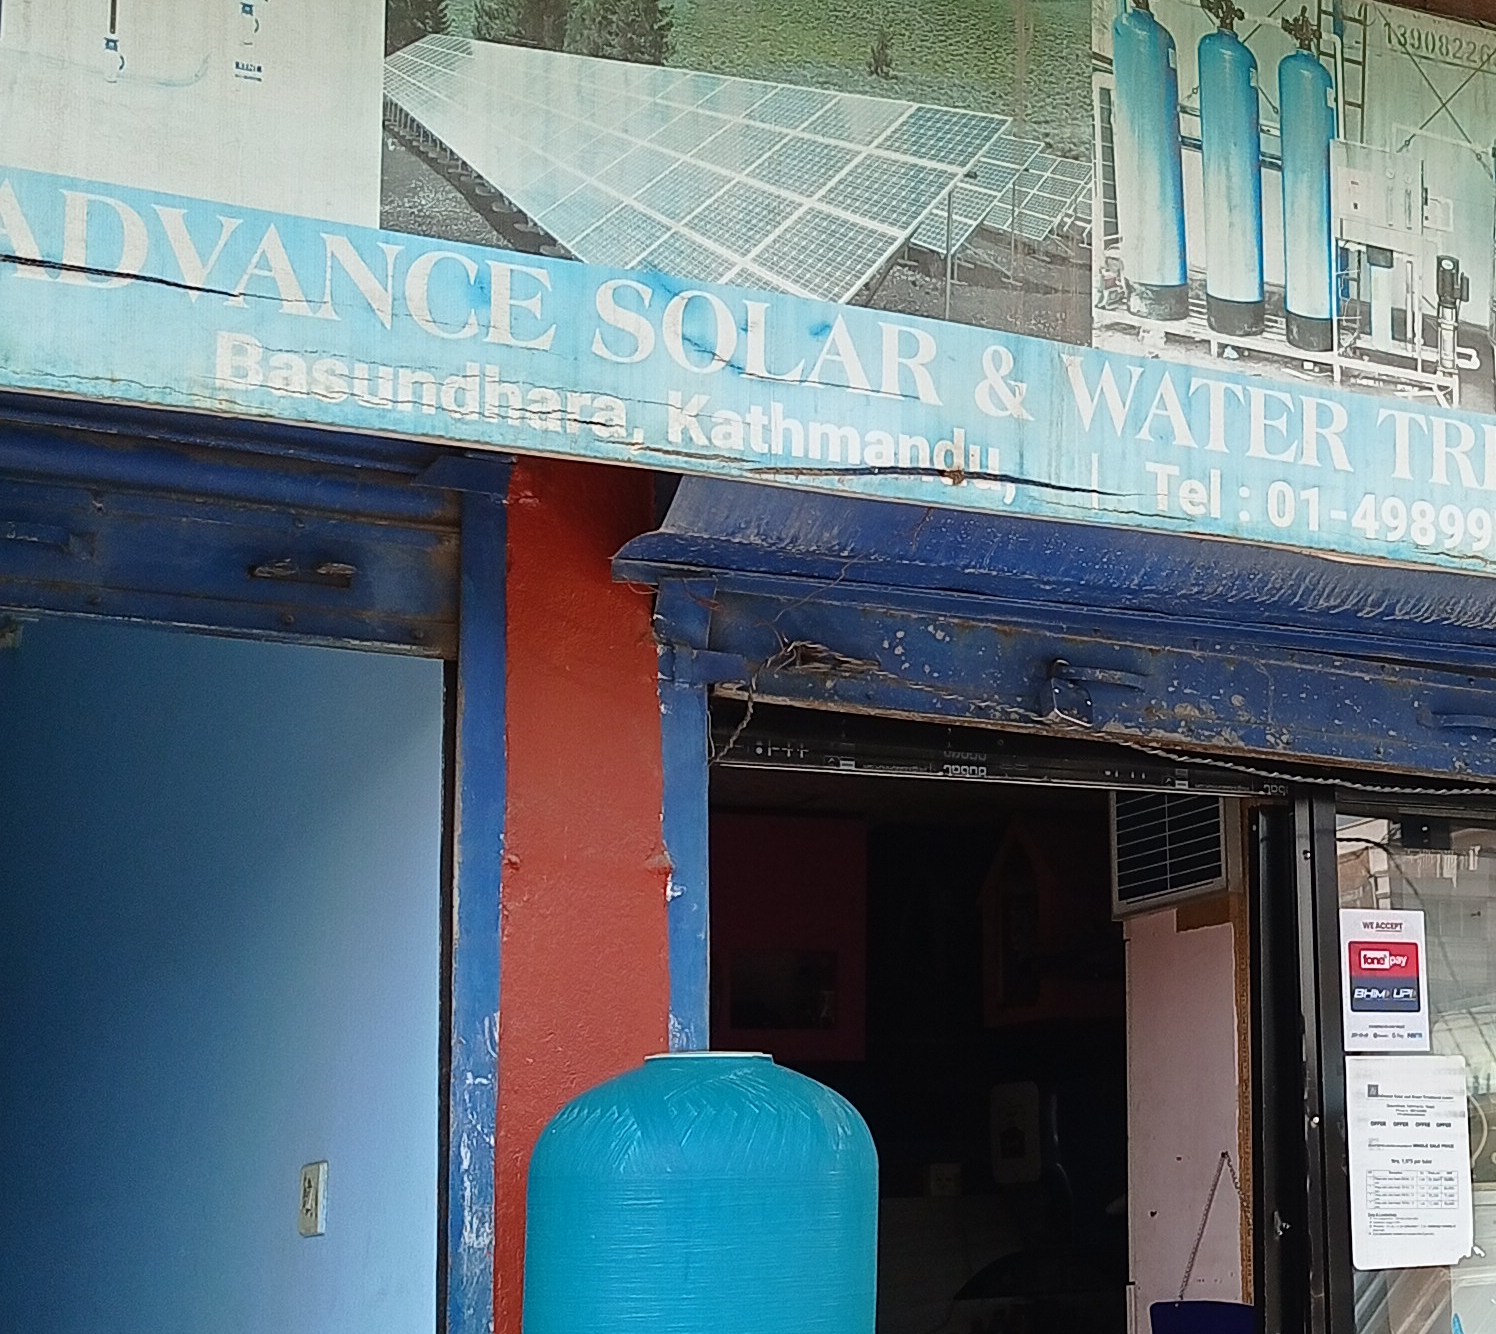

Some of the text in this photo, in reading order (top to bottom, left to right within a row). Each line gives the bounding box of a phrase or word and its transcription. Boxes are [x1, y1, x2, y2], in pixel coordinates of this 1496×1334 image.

[0, 177, 556, 352] ADVANCE
[591, 278, 943, 407] SOLAR
[975, 344, 1035, 421] &
[1062, 353, 1353, 472] WATER
[215, 330, 644, 453] Basundhara,
[668, 390, 1017, 505] Kathmandu,
[1145, 460, 1221, 520] Tel
[1362, 921, 1403, 930] WE ACCEPT
[1354, 987, 1415, 999] BHIM UPI
